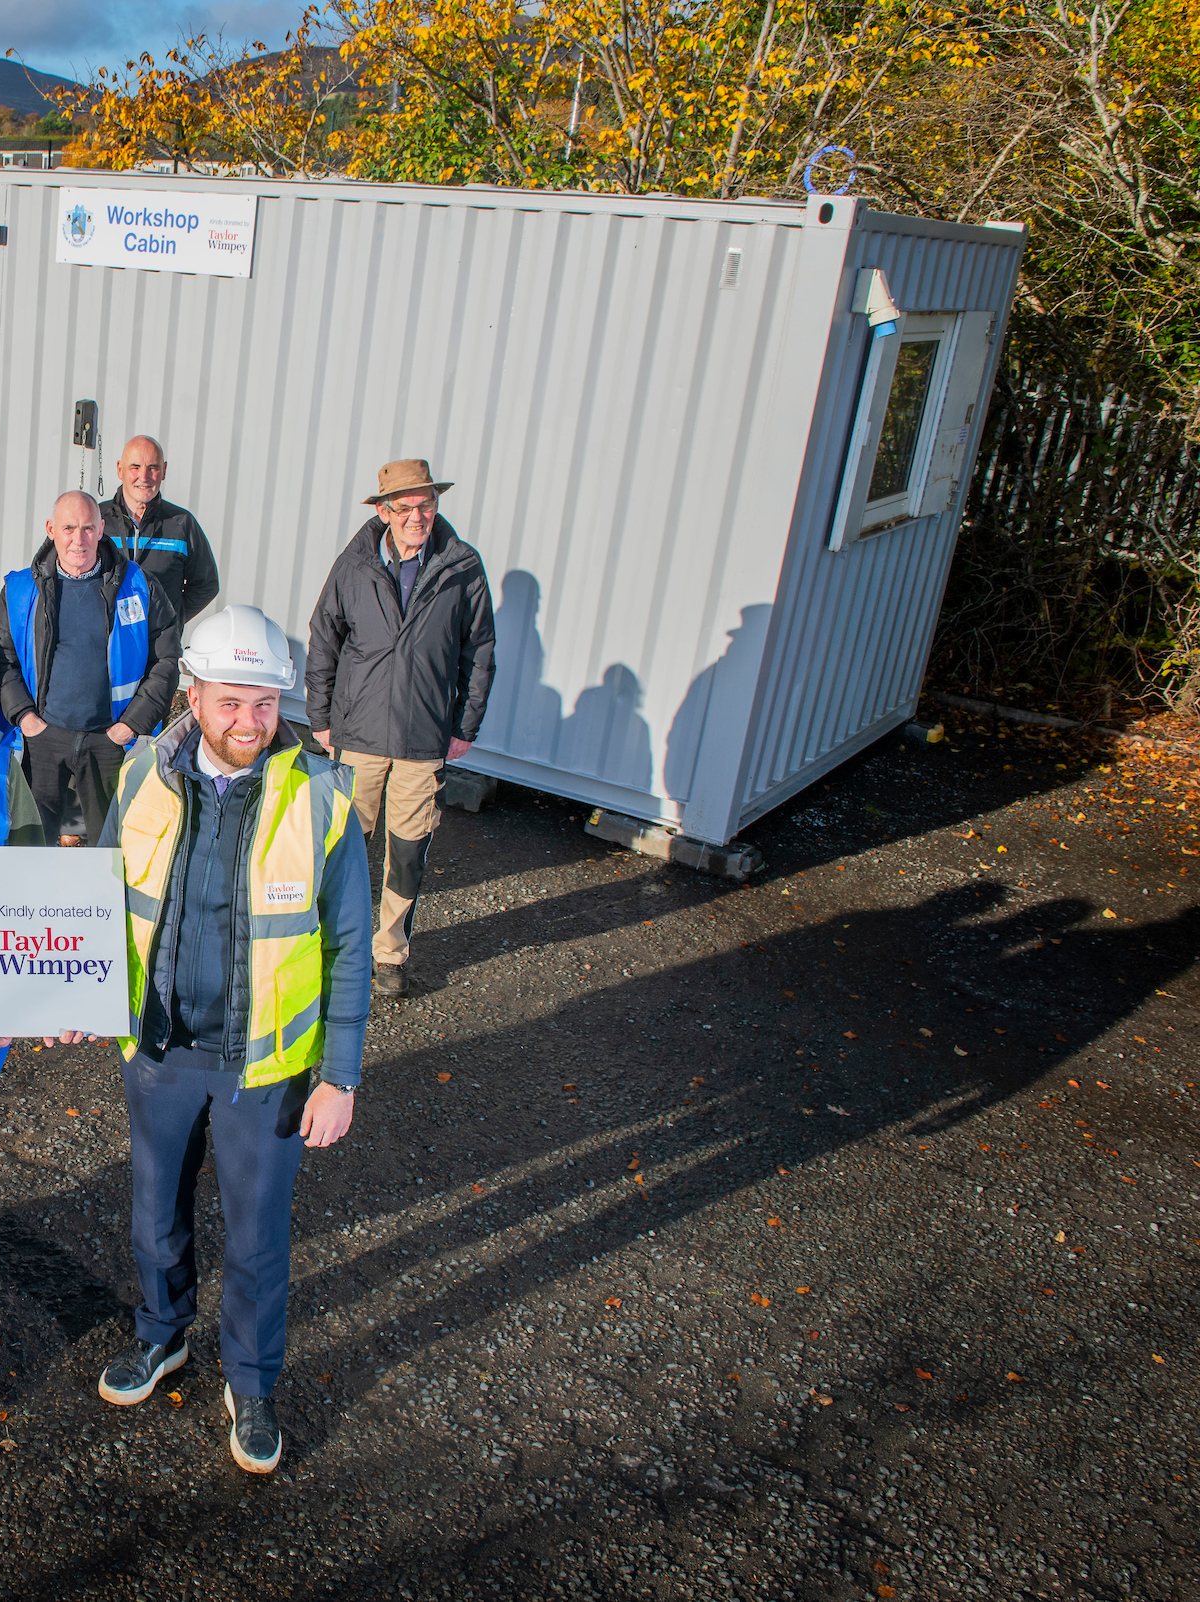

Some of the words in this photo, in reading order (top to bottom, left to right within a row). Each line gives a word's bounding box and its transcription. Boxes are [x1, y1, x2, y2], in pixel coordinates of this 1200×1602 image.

[107, 205, 199, 233] Workshop
[208, 229, 239, 242] Taylor
[124, 232, 176, 254] Cabin
[207, 239, 248, 255] Wimpey
[233, 648, 258, 656] Taylor
[233, 655, 265, 666] Wimpey
[267, 884, 295, 893] Taylor
[267, 892, 305, 901] Wimpey
[38, 905, 92, 918] donated
[96, 905, 112, 920] by
